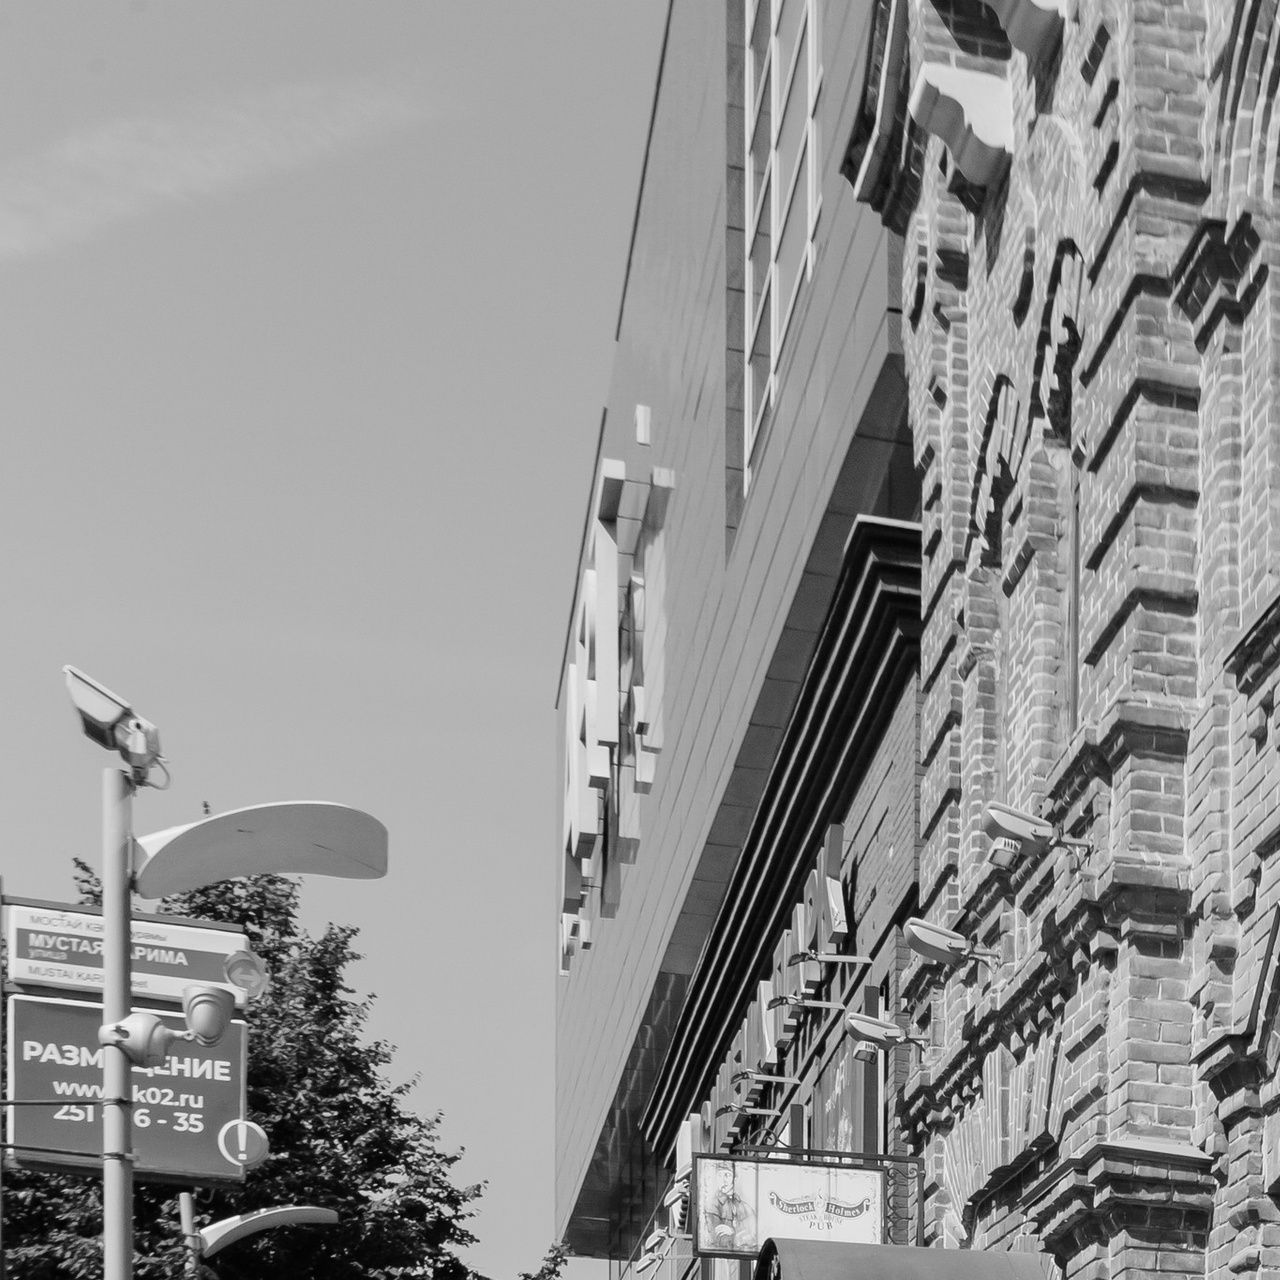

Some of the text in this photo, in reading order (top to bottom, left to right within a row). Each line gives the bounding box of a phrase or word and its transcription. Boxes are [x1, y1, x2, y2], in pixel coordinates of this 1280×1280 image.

[29, 933, 188, 966] МУСТАЯ РИМА
[76, 971, 105, 983] KAR
[23, 1041, 231, 1081] РАЗМНИЕ
[53, 1081, 204, 1109] wwwk02.ru
[778, 1201, 861, 1217] Sherlock Holmes
[809, 1221, 833, 1230] PUB
